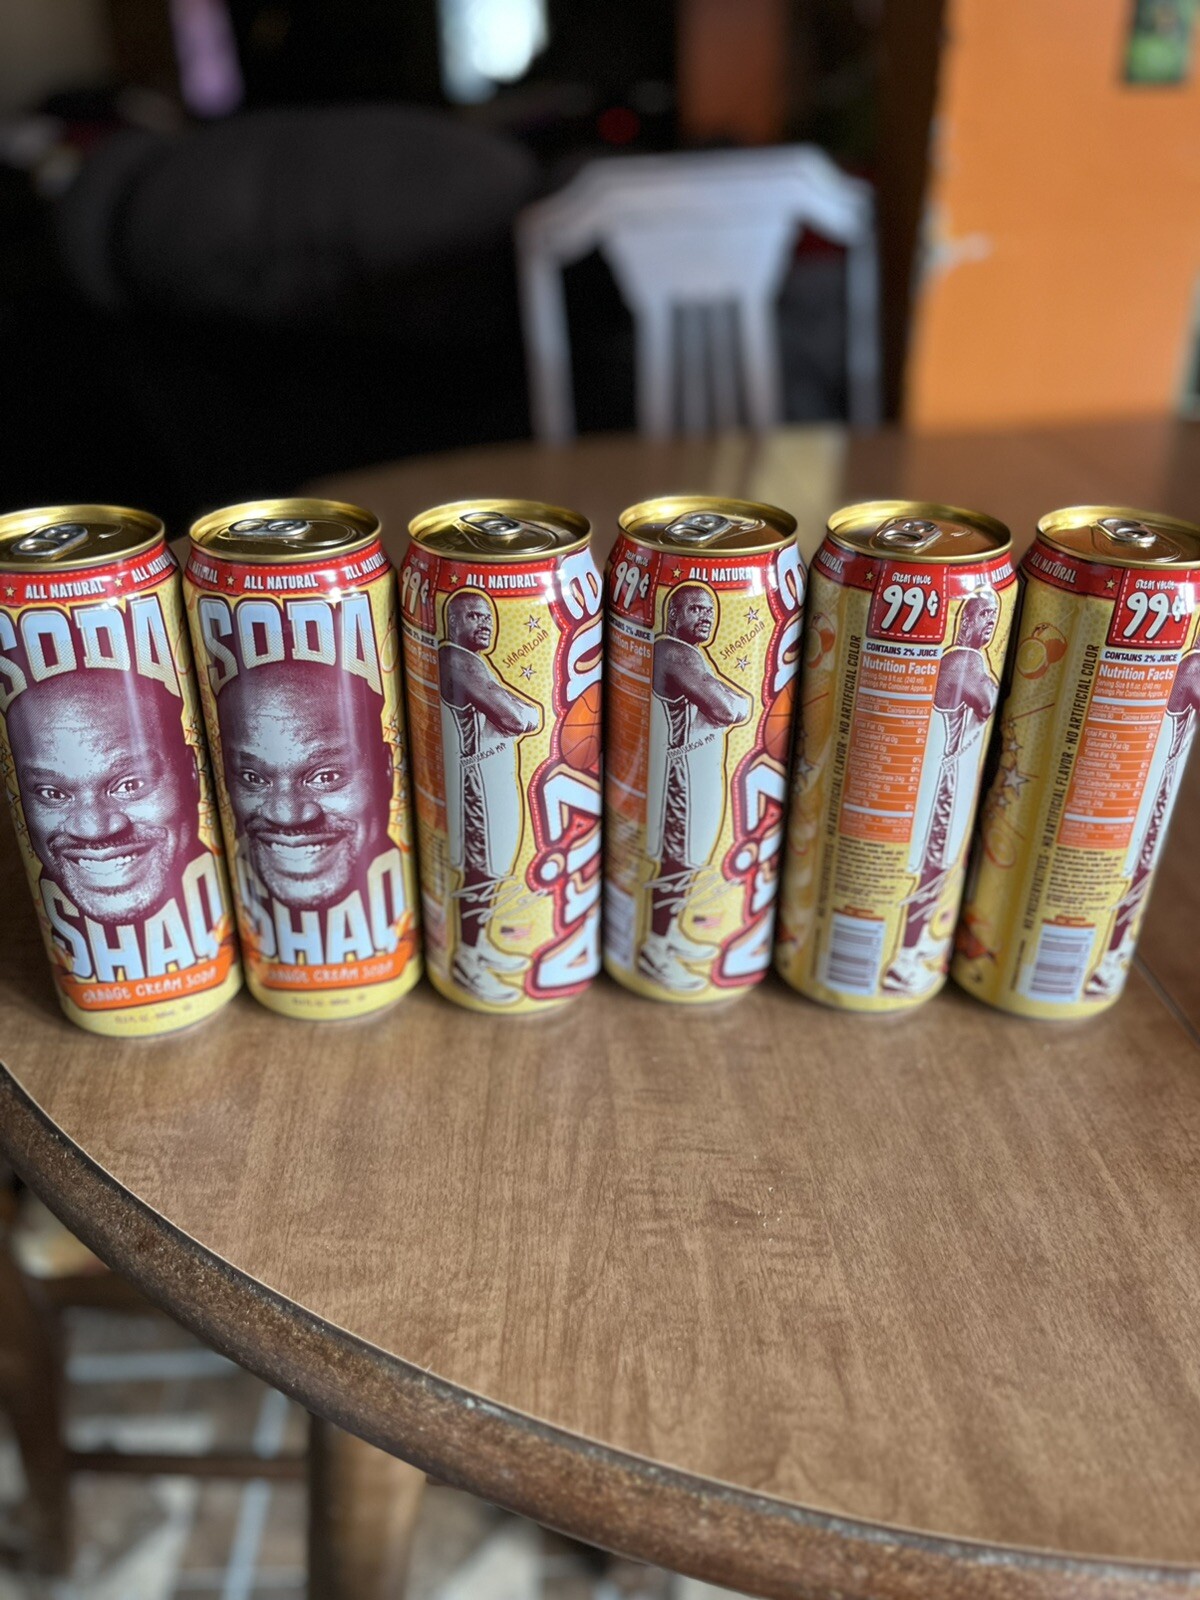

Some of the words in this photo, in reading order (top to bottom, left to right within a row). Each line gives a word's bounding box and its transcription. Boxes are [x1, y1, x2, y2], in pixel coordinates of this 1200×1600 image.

[131, 566, 150, 583] ALL
[244, 575, 265, 590] ALL
[266, 573, 319, 589] NATURAL
[465, 573, 486, 588] ALL
[488, 573, 538, 589] NATURAL
[688, 566, 709, 582] ALL
[711, 566, 756, 583] NATURA
[1039, 559, 1077, 584] NATURAL
[25, 584, 48, 600] ALL
[50, 579, 106, 598] NATURAL
[613, 561, 650, 609] 99¢
[880, 584, 939, 632] 99¢
[199, 594, 383, 696] SODA
[848, 635, 862, 668] COLOR
[866, 642, 901, 656] CONTAINS
[902, 647, 915, 656] 2%
[917, 648, 938, 657] JUICE
[862, 656, 906, 674] Nutrition
[908, 662, 936, 675] Facts
[1081, 644, 1100, 676] COLOR
[1104, 650, 1142, 663] CONTAINS
[1143, 653, 1156, 663] 2%
[1157, 652, 1178, 662] JUICE
[1099, 664, 1145, 680] Nutrition
[1147, 667, 1174, 680] Facts
[841, 669, 858, 722] ARTIFICIAL
[1068, 678, 1092, 730] ARTIFICIAL
[839, 722, 850, 735] NO
[1065, 729, 1079, 745] NO
[1056, 750, 1075, 785] FLAVOR
[236, 847, 406, 966] SHAQ
[40, 851, 224, 984] SHAQ
[135, 979, 182, 997] CREAM
